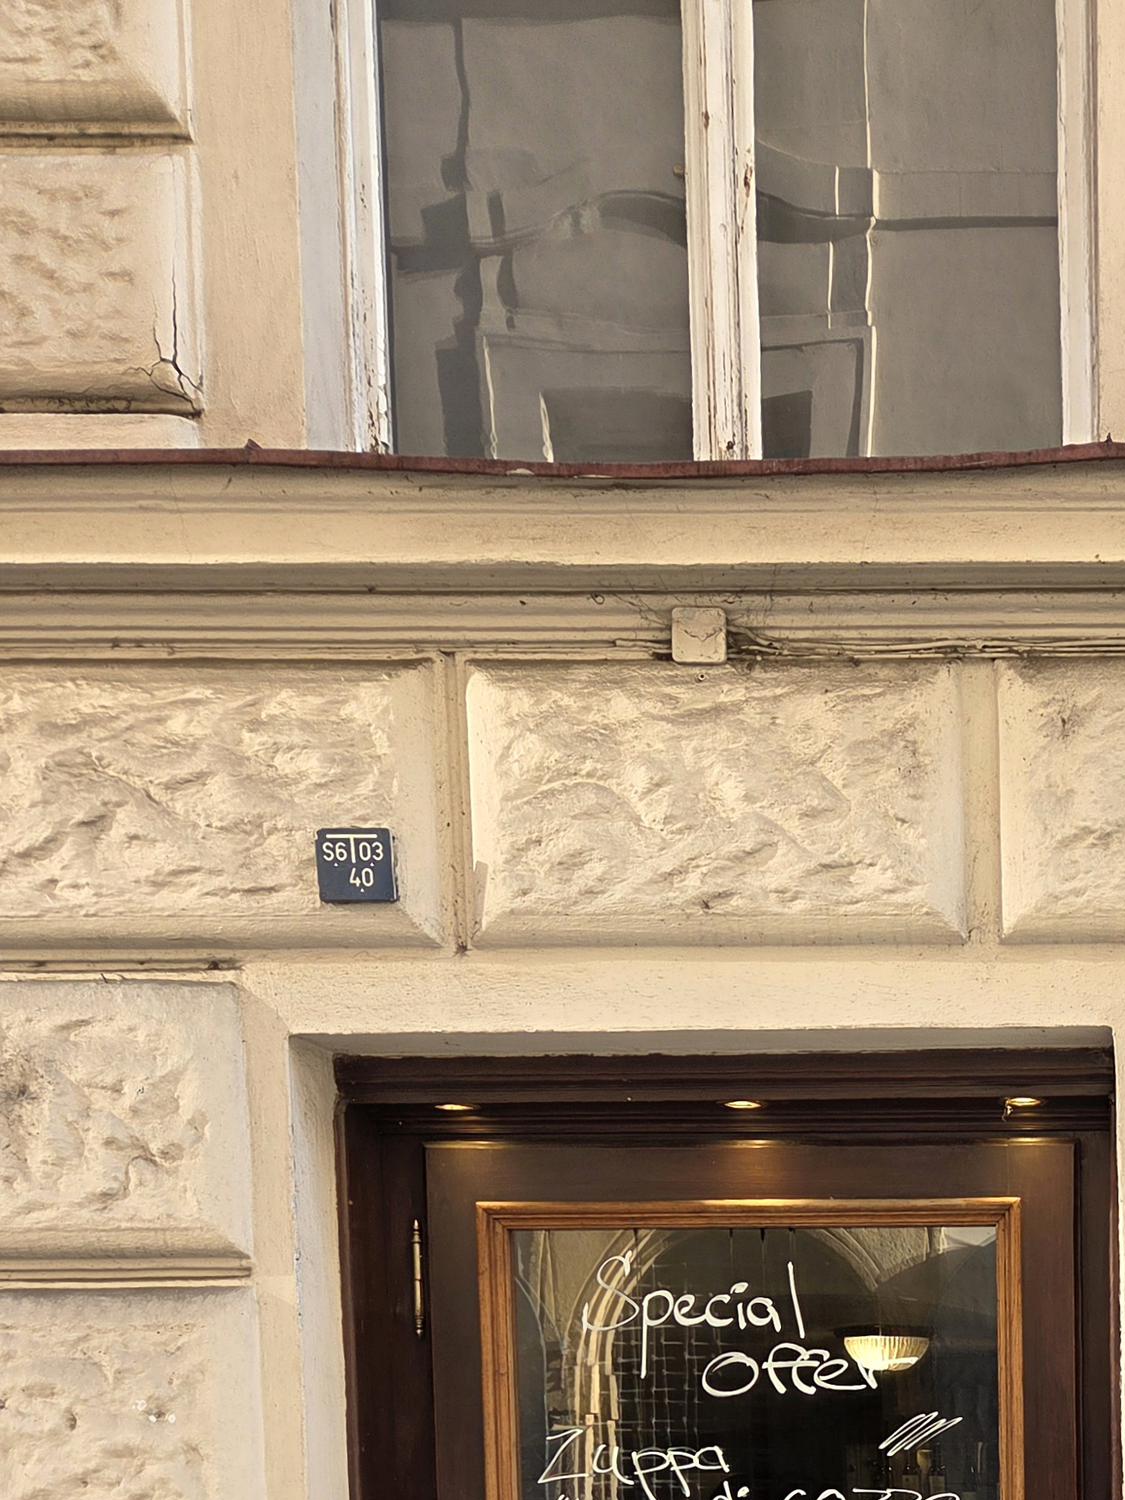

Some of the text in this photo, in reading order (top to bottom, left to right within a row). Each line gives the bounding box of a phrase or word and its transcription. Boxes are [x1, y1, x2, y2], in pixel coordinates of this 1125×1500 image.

[359, 841, 384, 861] 03
[349, 867, 374, 887] 40
[581, 1250, 806, 1379] Special
[701, 1342, 919, 1397] Offer
